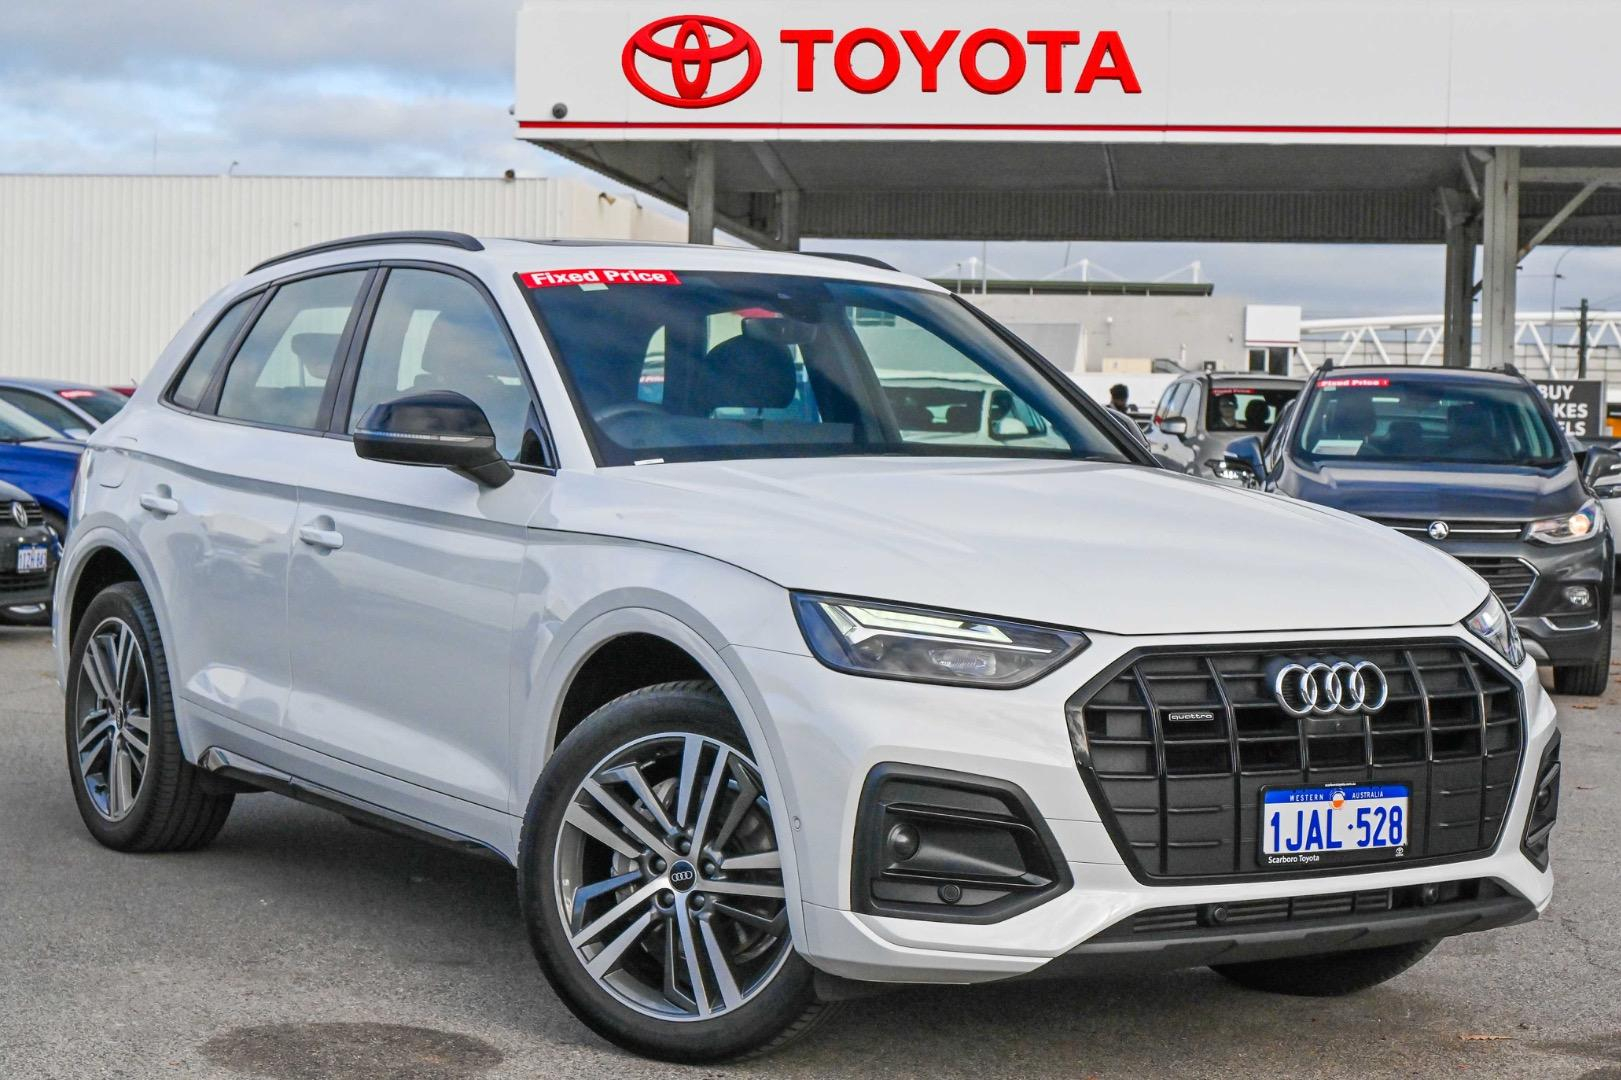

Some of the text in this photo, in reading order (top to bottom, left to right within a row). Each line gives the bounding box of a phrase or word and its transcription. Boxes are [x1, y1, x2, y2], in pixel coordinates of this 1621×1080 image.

[780, 27, 1142, 95] TOYOTA
[531, 271, 667, 285] Fixed Price
[1290, 791, 1384, 802] WESTERN AUSTRALIA
[1268, 854, 1320, 864] Scarboro Toyota
